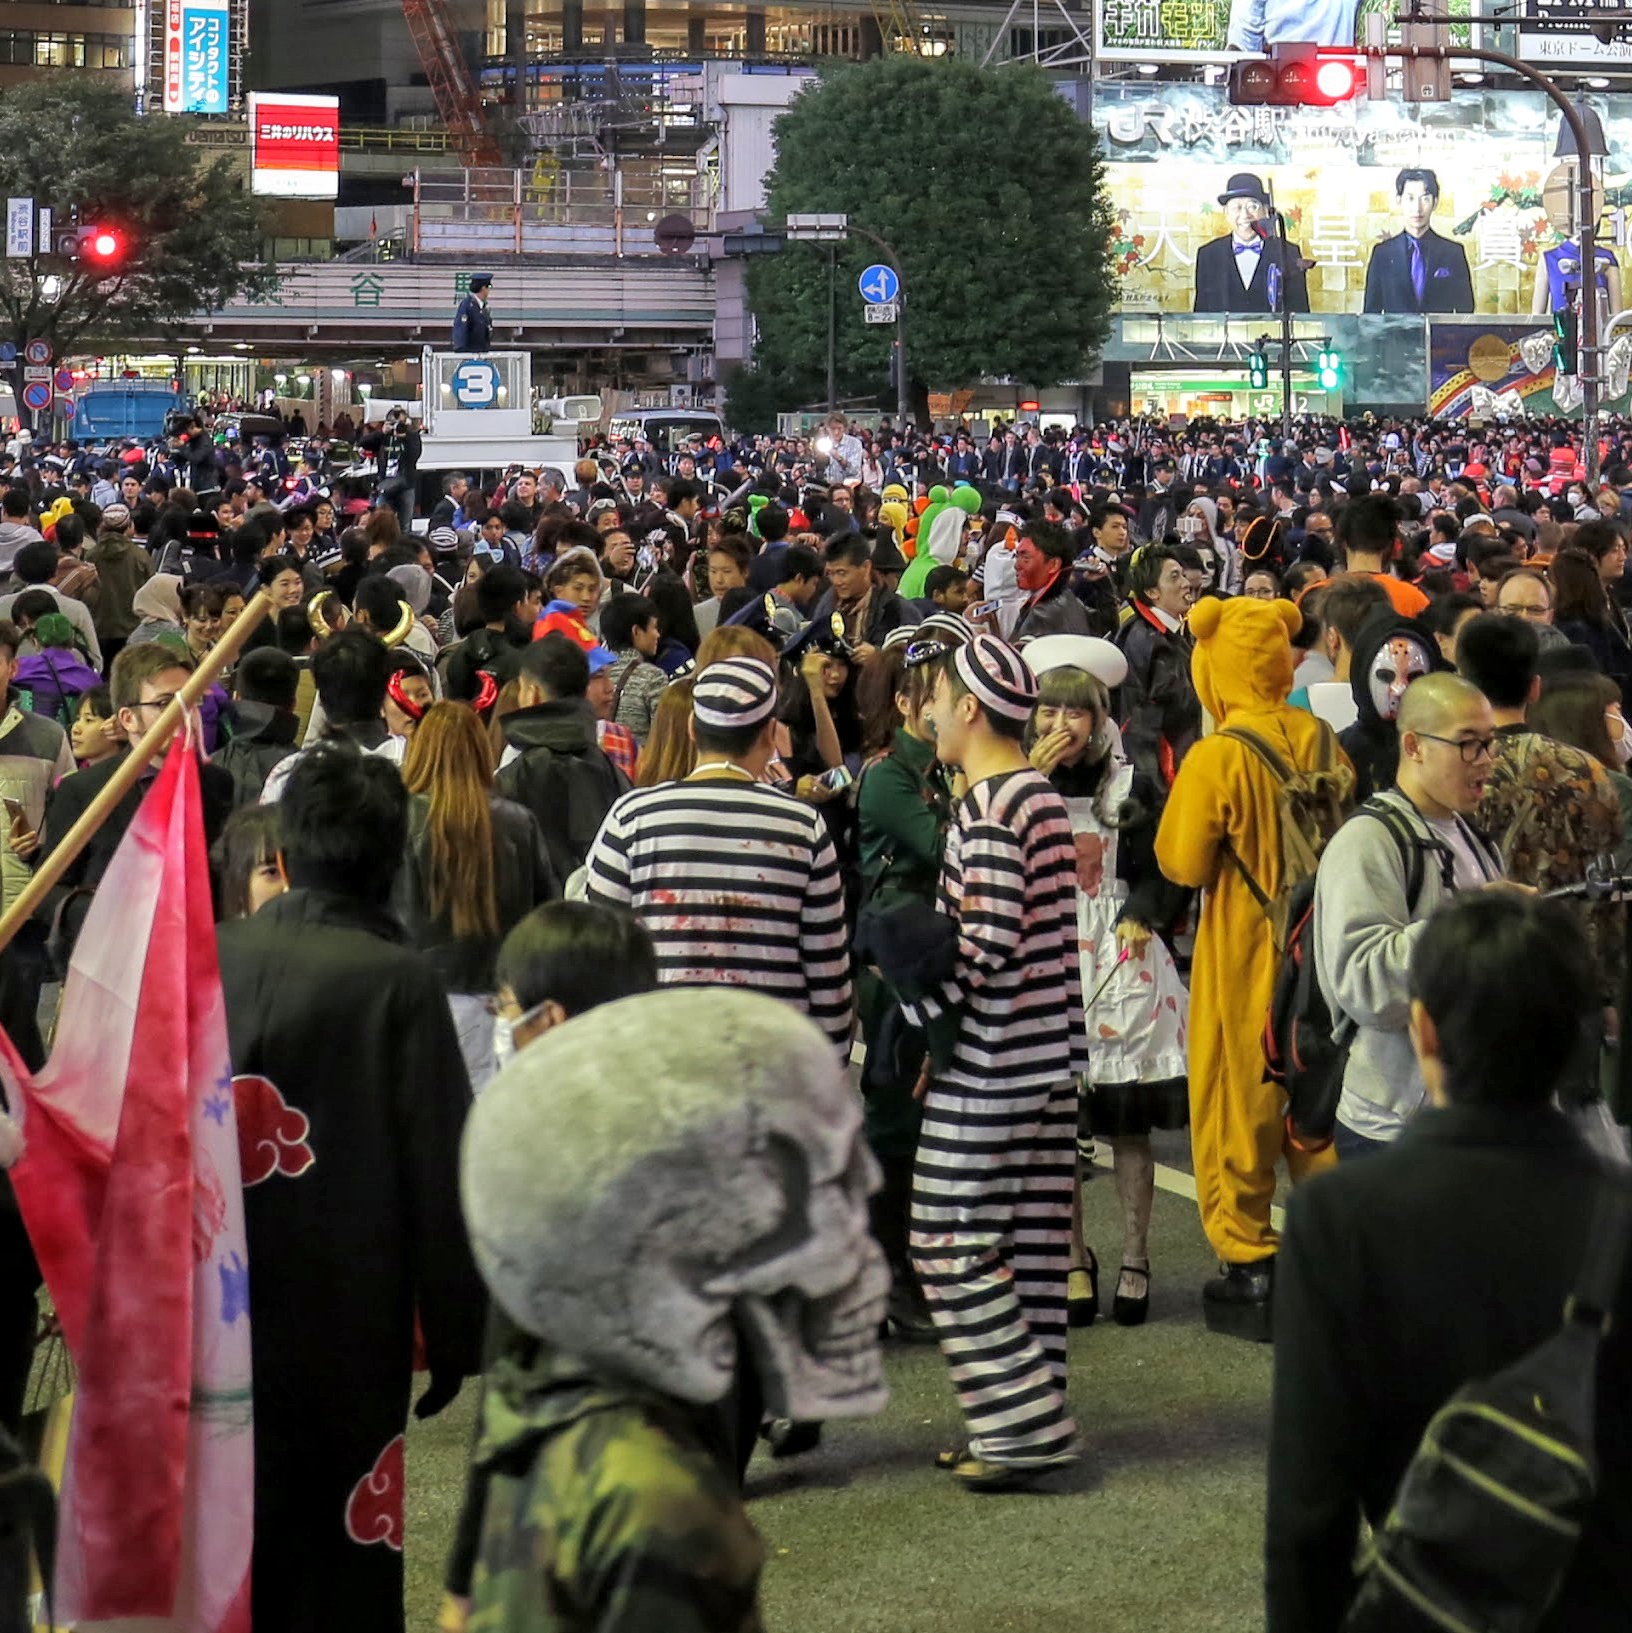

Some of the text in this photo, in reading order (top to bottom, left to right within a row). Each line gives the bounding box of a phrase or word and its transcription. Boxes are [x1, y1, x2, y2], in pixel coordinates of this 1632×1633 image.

[188, 16, 207, 101] アイシティ
[206, 17, 220, 104] コンタクトの
[260, 124, 334, 142] 三井のリハウス
[456, 365, 495, 404] 3
[1253, 394, 1275, 409] JR
[1298, 396, 1308, 413] 2
